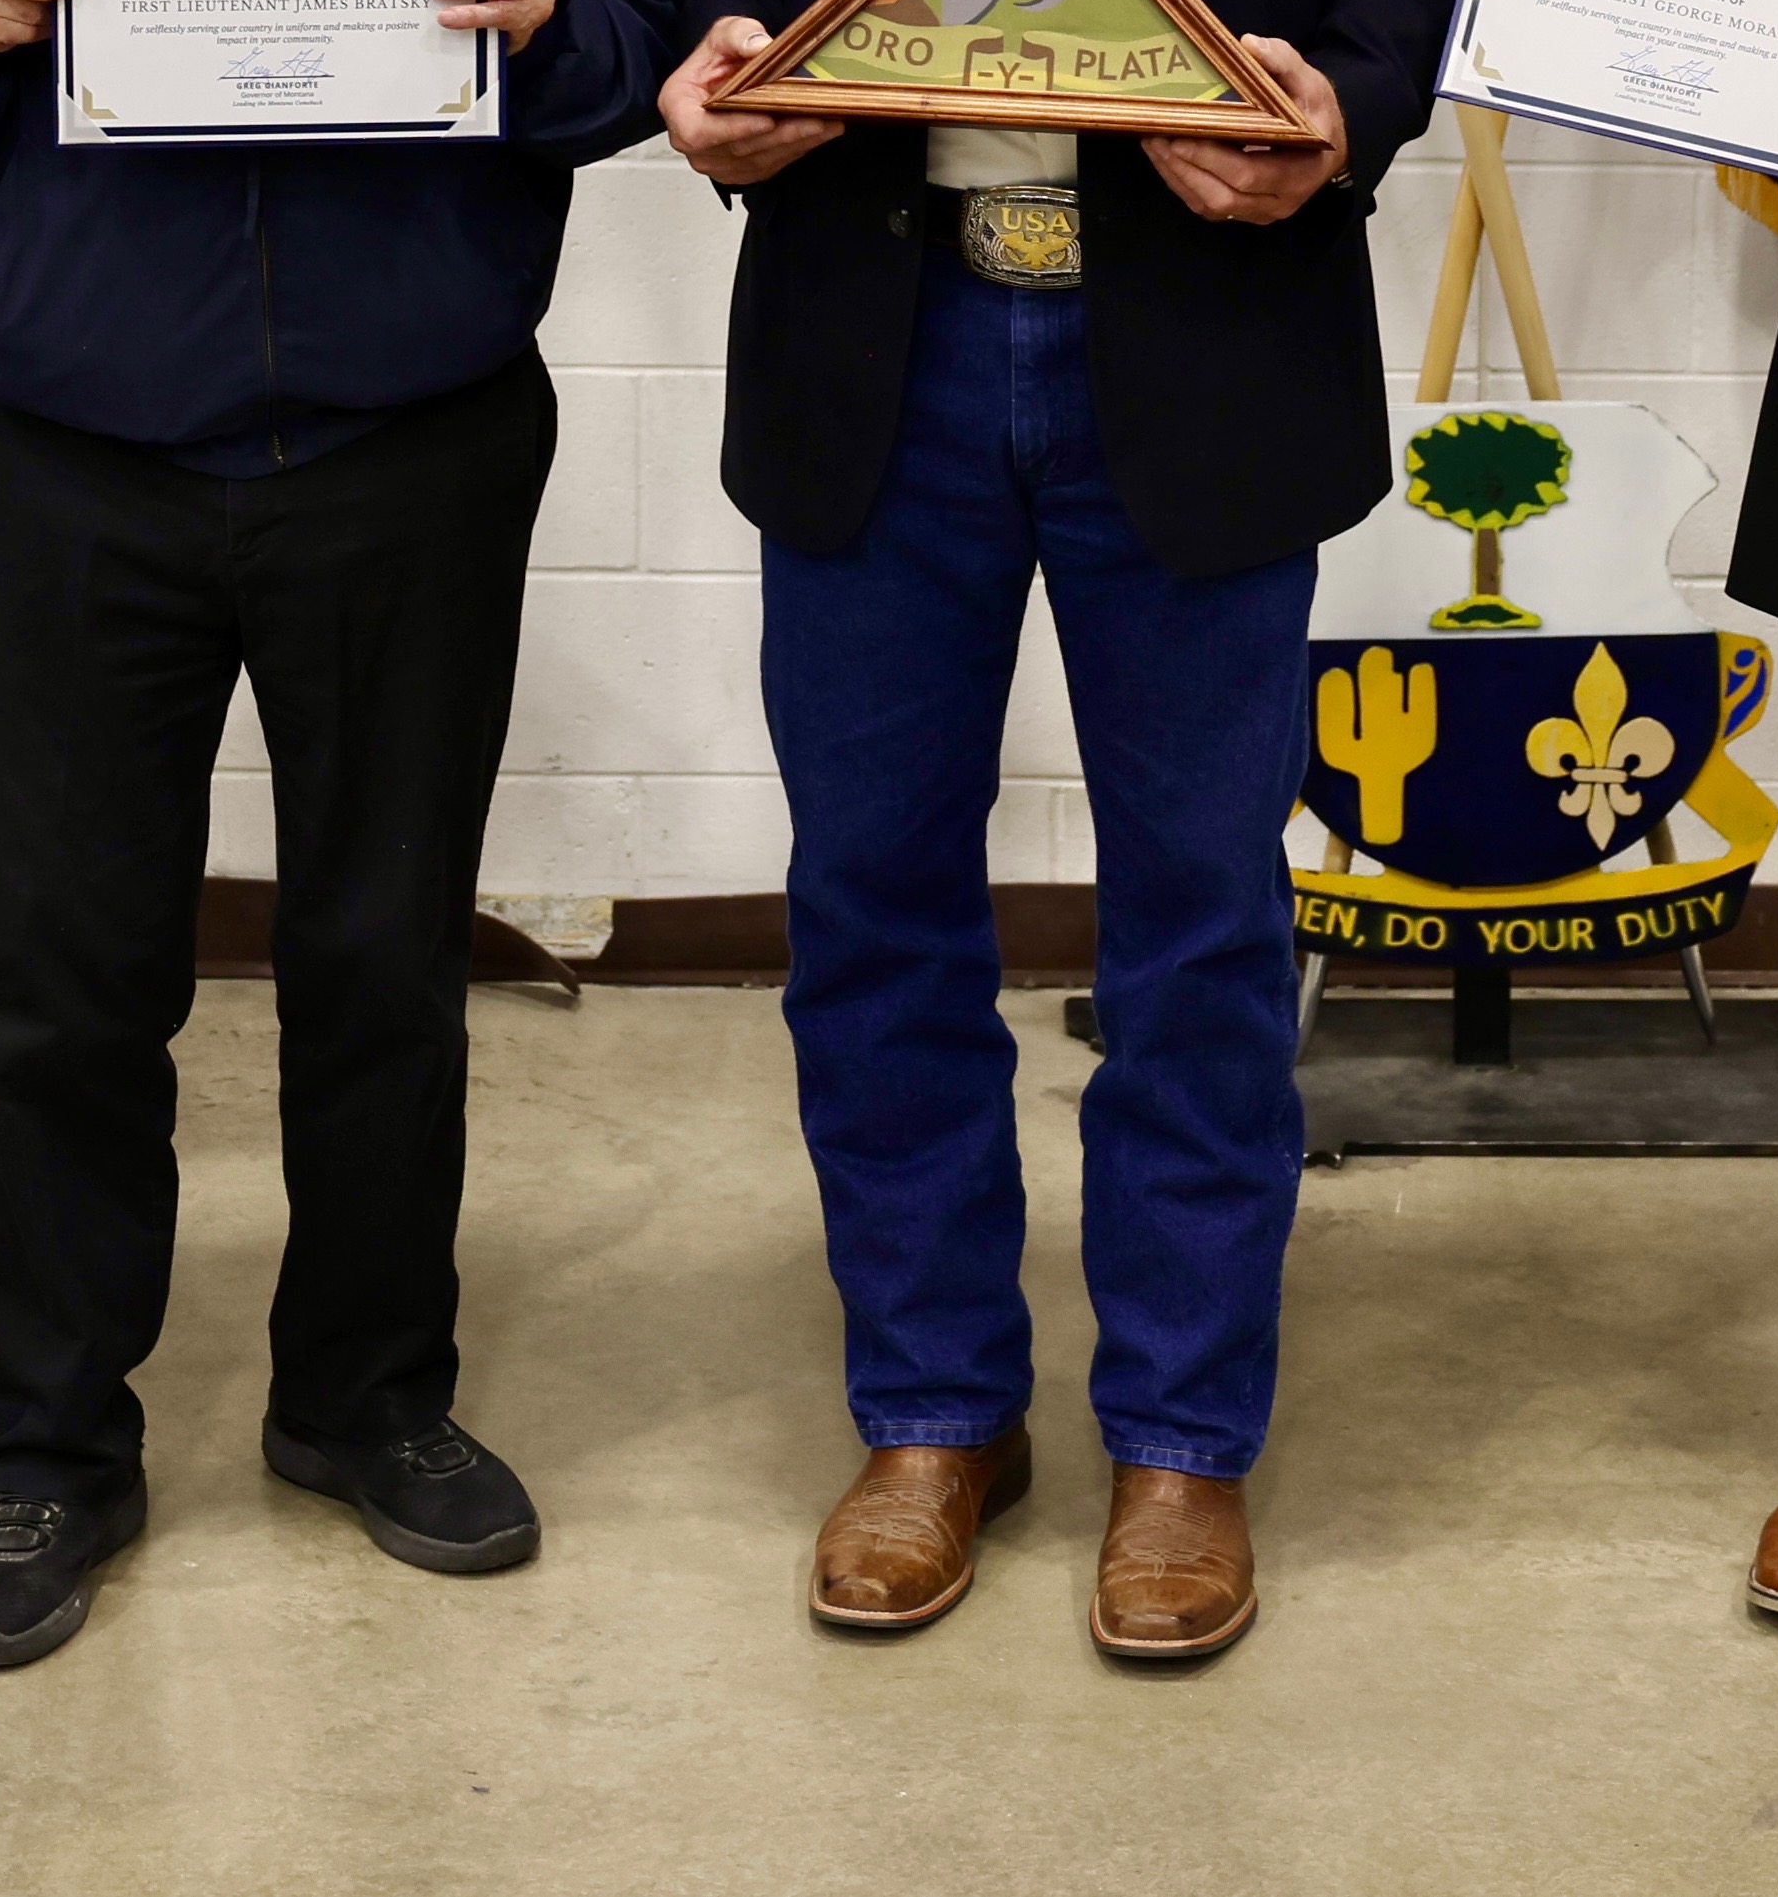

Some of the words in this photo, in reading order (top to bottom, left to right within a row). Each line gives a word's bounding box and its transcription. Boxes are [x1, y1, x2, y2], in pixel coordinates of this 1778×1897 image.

[121, 0, 171, 12] FIRST
[1654, 0, 1723, 25] GEORGE
[129, 24, 144, 35] for
[145, 23, 186, 35] selflessly
[186, 24, 219, 35] serving
[238, 24, 273, 34] country
[274, 22, 284, 32] in
[285, 22, 321, 33] uniform
[322, 21, 341, 31] and
[342, 21, 376, 32] making
[384, 20, 420, 32] positive
[216, 35, 248, 46] impact
[249, 34, 258, 44] in
[259, 36, 281, 46] your
[282, 33, 334, 44] community.
[1550, 0, 1590, 17] selflessly
[1589, 9, 1622, 24] serving
[1621, 17, 1638, 26] our
[1638, 21, 1672, 36] country
[1672, 27, 1682, 37] in
[1682, 31, 1718, 45] uniform
[1718, 40, 1737, 49] and
[1737, 44, 1771, 59] making
[842, 22, 934, 67] ORO
[1074, 44, 1193, 82] PLATA
[1614, 25, 1645, 40] impact
[1645, 34, 1655, 43] in
[1654, 37, 1677, 47] your
[1677, 42, 1726, 60] community.
[235, 81, 263, 90] GREG
[1622, 75, 1649, 87] GREG
[1001, 207, 1072, 233] USA
[1383, 913, 1447, 950] DO
[1478, 917, 1595, 954] YOUR
[1616, 892, 1726, 947] DUTY
